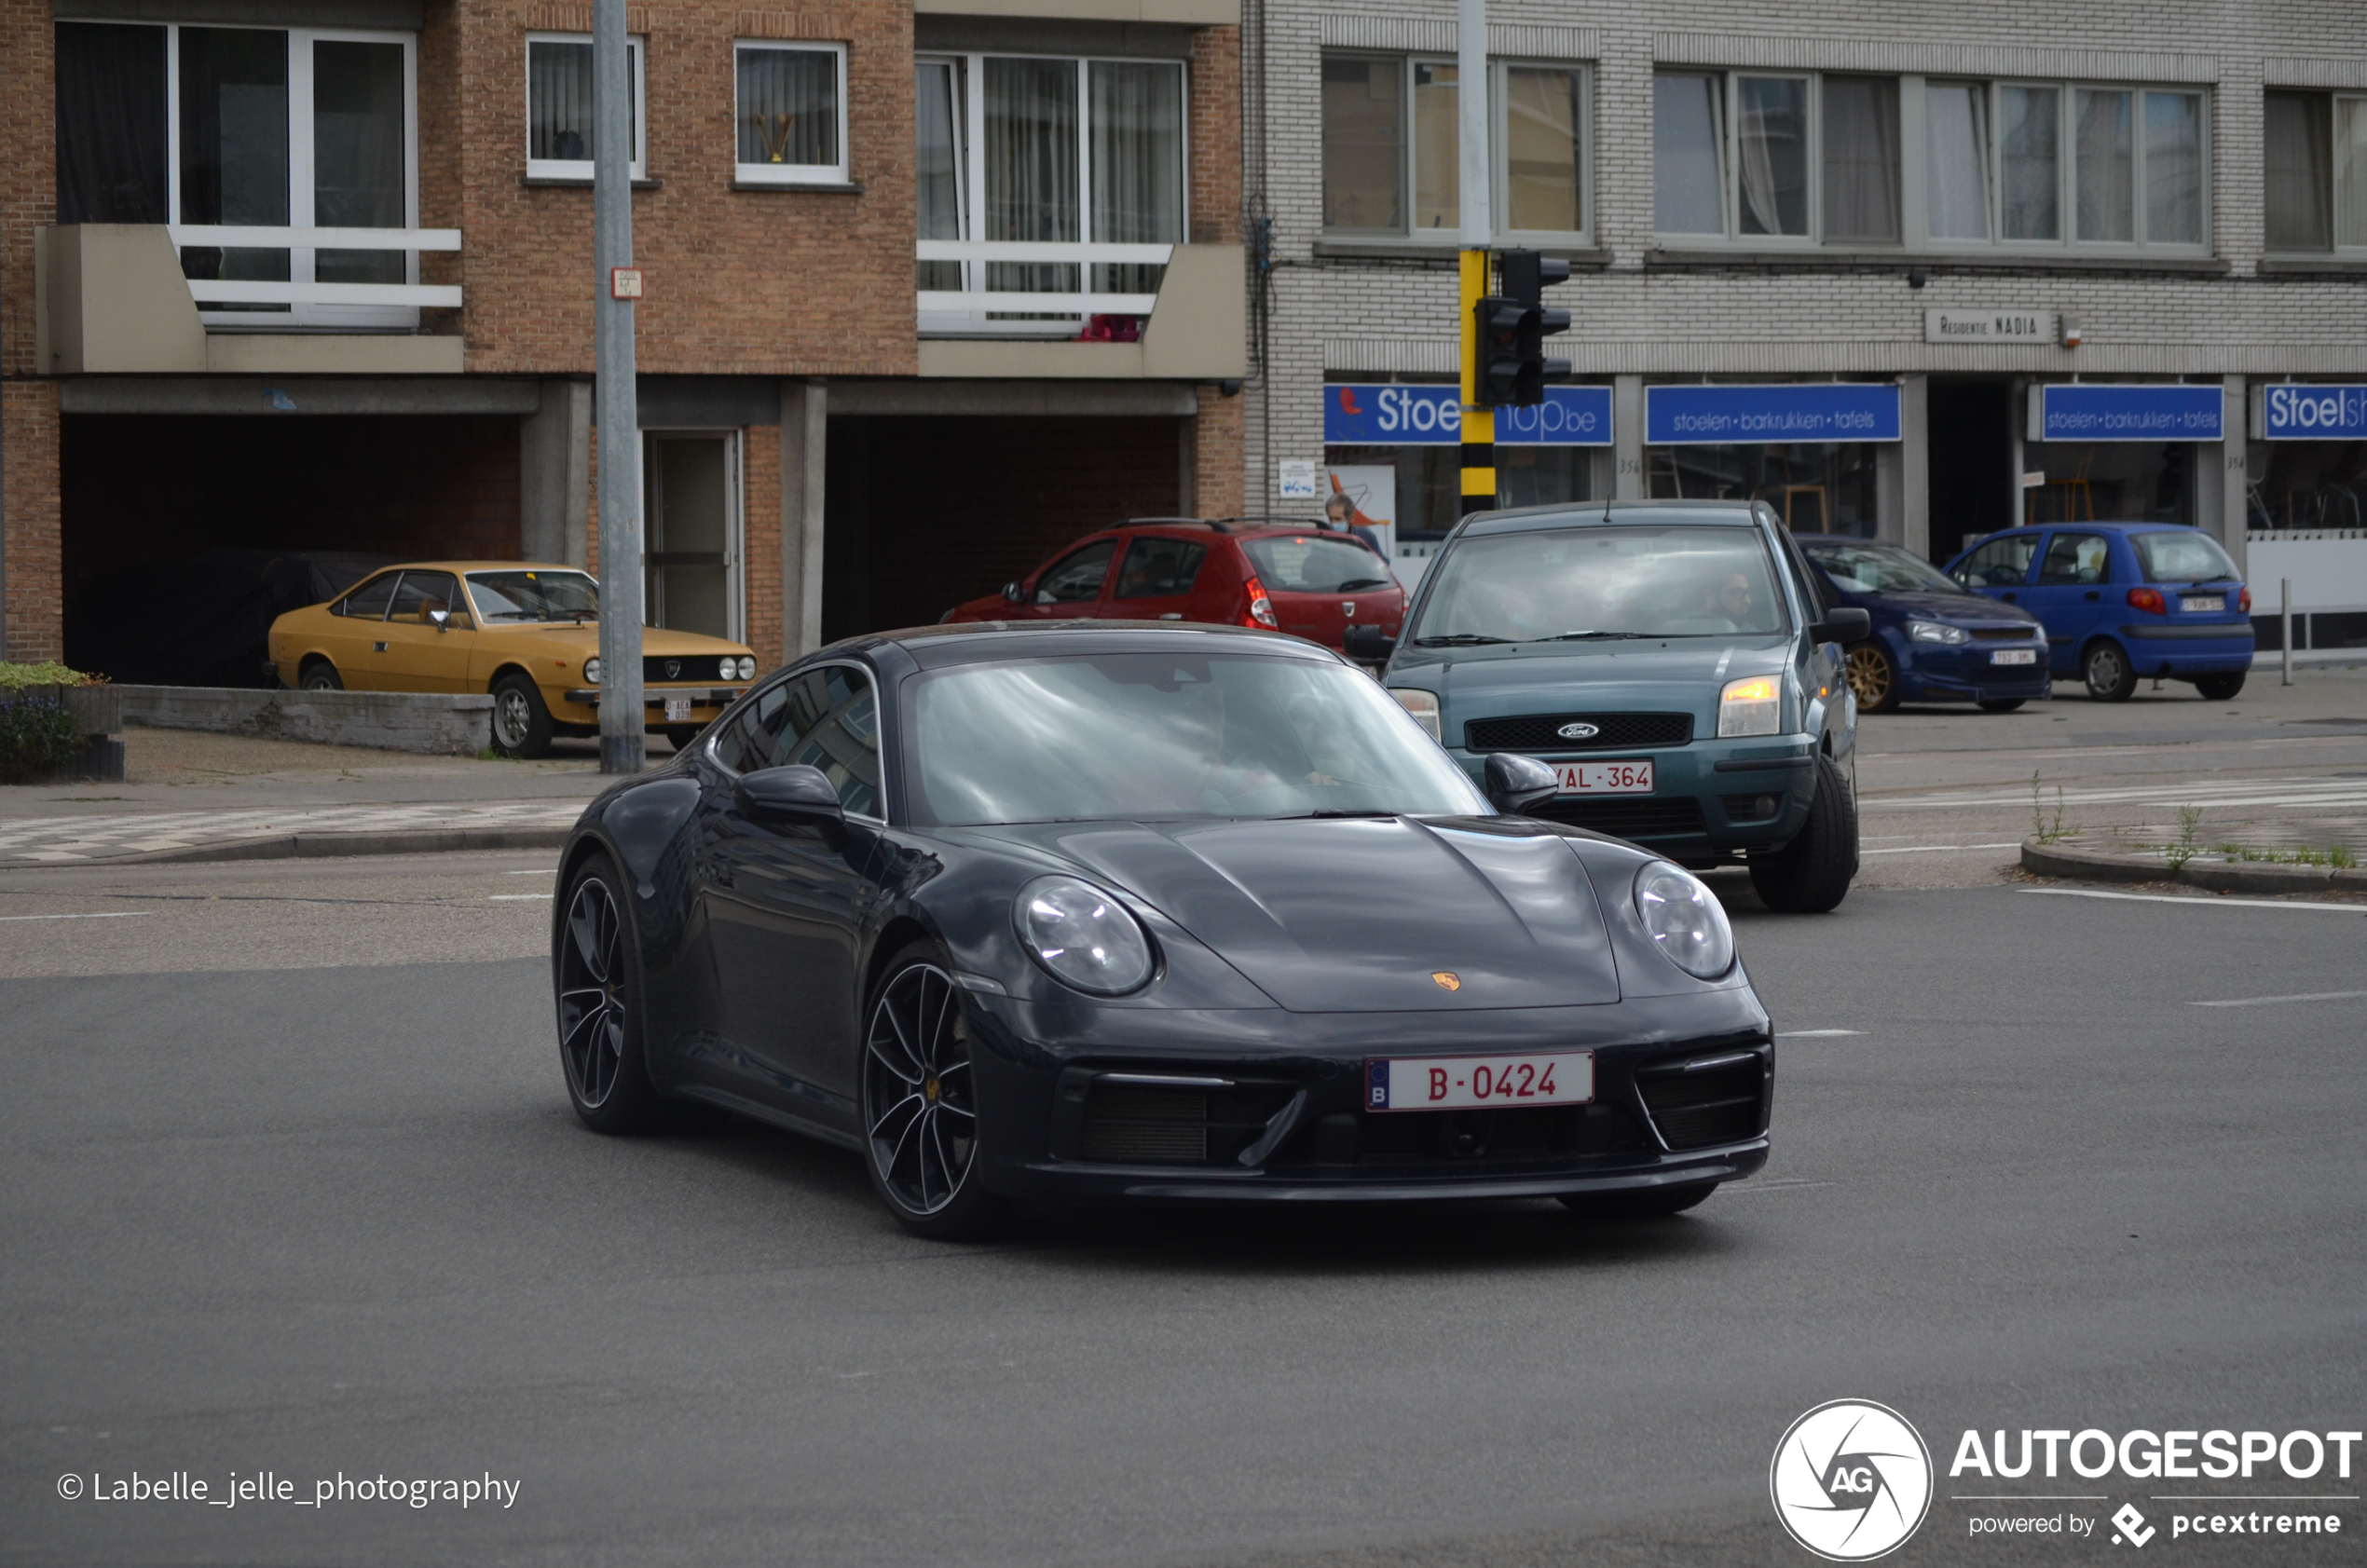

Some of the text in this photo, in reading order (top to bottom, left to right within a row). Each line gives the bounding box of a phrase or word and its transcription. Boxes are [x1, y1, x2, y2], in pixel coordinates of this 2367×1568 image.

[1995, 317, 2037, 335] NADIA
[1674, 410, 1875, 430] stoelen barkrukken tafels
[2048, 411, 2218, 429] stoelen barkrukken tafels
[1620, 459, 1640, 474] 356
[1566, 726, 1590, 736] Ford
[1372, 1086, 1386, 1103] B
